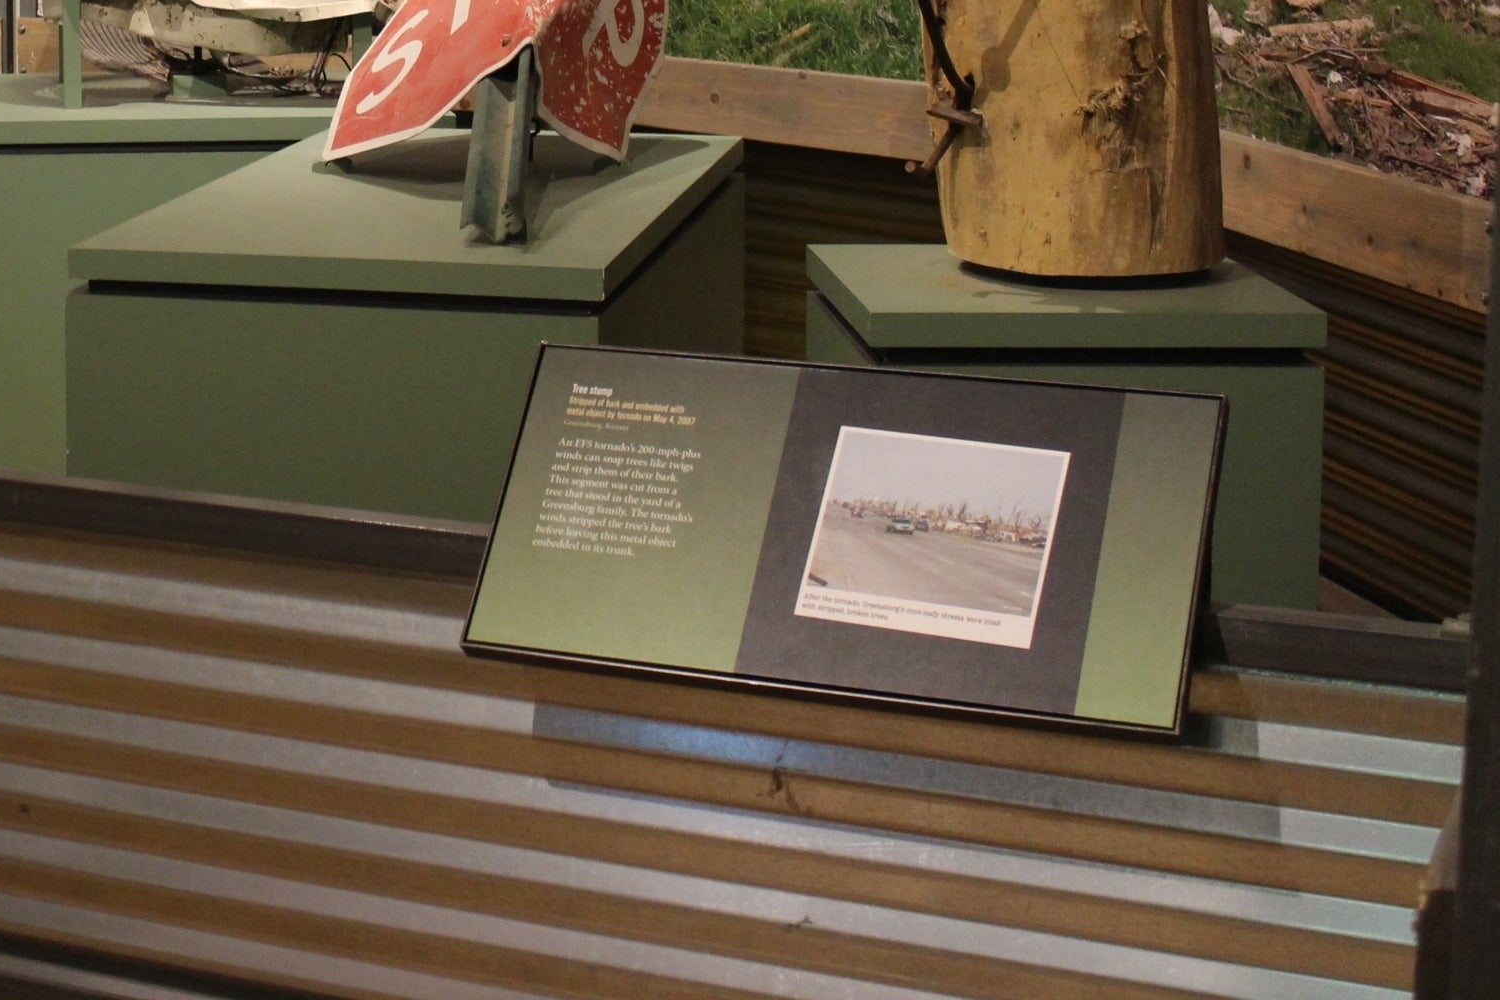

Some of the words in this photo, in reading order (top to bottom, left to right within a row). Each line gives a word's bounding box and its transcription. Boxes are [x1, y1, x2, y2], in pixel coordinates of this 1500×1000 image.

[572, 383, 588, 395] Tree
[589, 386, 613, 397] stump
[568, 396, 597, 408] Stripped
[598, 398, 605, 407] of
[606, 399, 620, 408] bark
[622, 401, 634, 410] and
[635, 403, 669, 412] embedded
[670, 405, 685, 414] with
[566, 407, 585, 416] metal
[585, 409, 606, 418] object
[607, 410, 615, 420] by
[617, 412, 642, 421] tornado
[652, 414, 667, 424] May
[668, 415, 675, 425] 4,
[677, 416, 696, 426] 2007
[558, 437, 572, 447] An
[575, 439, 592, 448] EF5
[595, 441, 636, 453] tornado's
[638, 445, 701, 459] 200-mph-plus
[556, 451, 582, 461] winds
[584, 453, 600, 462] can
[602, 455, 624, 467] snap
[626, 456, 648, 467] trees
[650, 458, 667, 468] like
[669, 461, 693, 472] twigs
[551, 463, 570, 472] and
[571, 464, 592, 477] strip
[594, 466, 618, 476] them
[619, 468, 630, 478] of
[631, 470, 653, 479] their
[655, 472, 678, 482] bark.
[550, 474, 569, 483] This
[571, 477, 609, 488] segment
[611, 482, 628, 490] was
[630, 482, 645, 492] cut
[646, 483, 669, 495] from
[545, 488, 562, 497] tree
[565, 488, 582, 499] that
[585, 491, 611, 501] stood
[612, 493, 622, 502] in
[624, 494, 638, 504] the
[641, 495, 662, 507] yard
[663, 498, 675, 508] of
[675, 501, 681, 509] a
[542, 499, 595, 514] Greensburg
[596, 505, 627, 518] family.
[631, 508, 648, 518] The
[650, 510, 693, 522] tornado's
[539, 512, 566, 522] winds
[568, 515, 606, 528] stripped
[608, 518, 623, 528] the
[625, 520, 649, 531] tree's
[650, 523, 672, 534] bark
[535, 523, 564, 535] before
[565, 527, 598, 540] leaving
[600, 529, 618, 540] this
[620, 532, 646, 544] metal
[648, 536, 677, 548] object
[532, 538, 579, 550] embedded
[581, 541, 591, 551] in
[593, 542, 605, 552] its
[606, 544, 635, 557] trunk.
[803, 592, 820, 602] After
[822, 594, 833, 603] the
[862, 599, 905, 614] Greensburg's
[941, 610, 965, 623] streets
[966, 615, 983, 625] were
